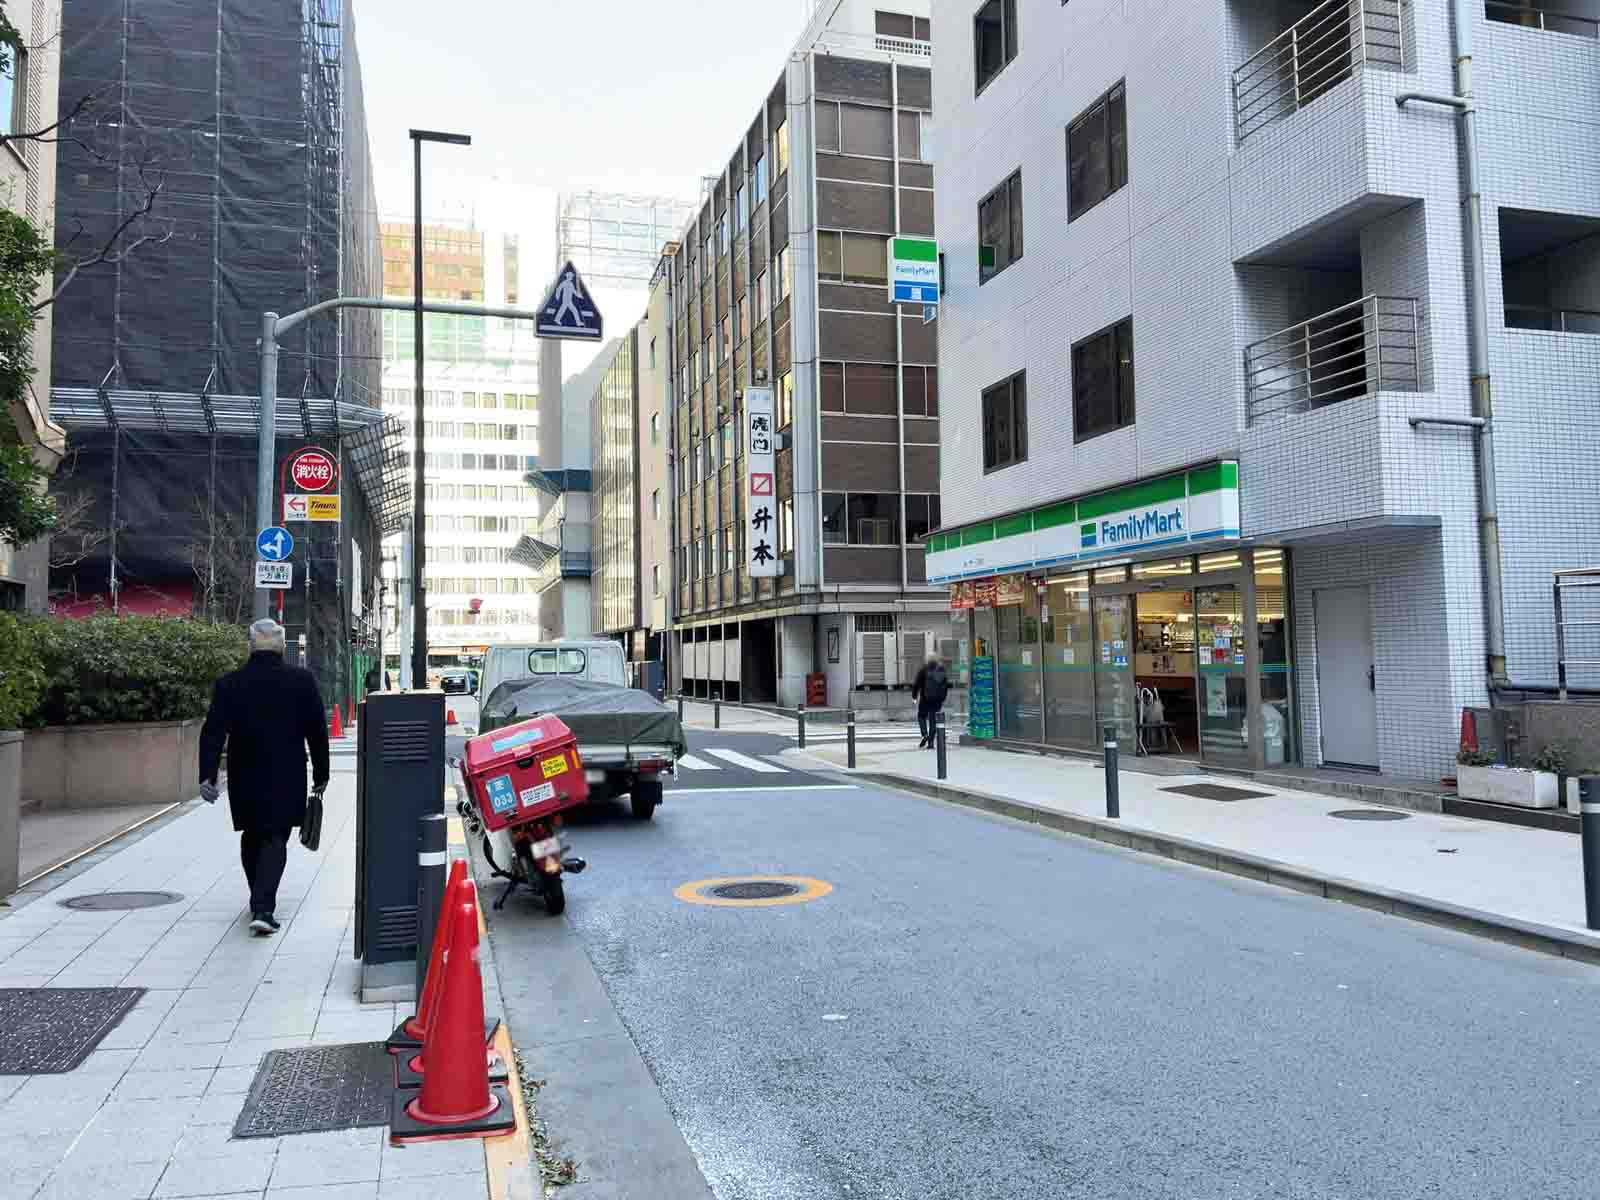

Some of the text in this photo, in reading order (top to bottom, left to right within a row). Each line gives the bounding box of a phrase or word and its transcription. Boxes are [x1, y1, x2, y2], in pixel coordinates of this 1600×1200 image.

[296, 464, 329, 479] 消火栓
[311, 501, 336, 510] Times
[1101, 507, 1182, 544] FamilyMart
[752, 507, 774, 566] 升本
[493, 793, 514, 807] 033
